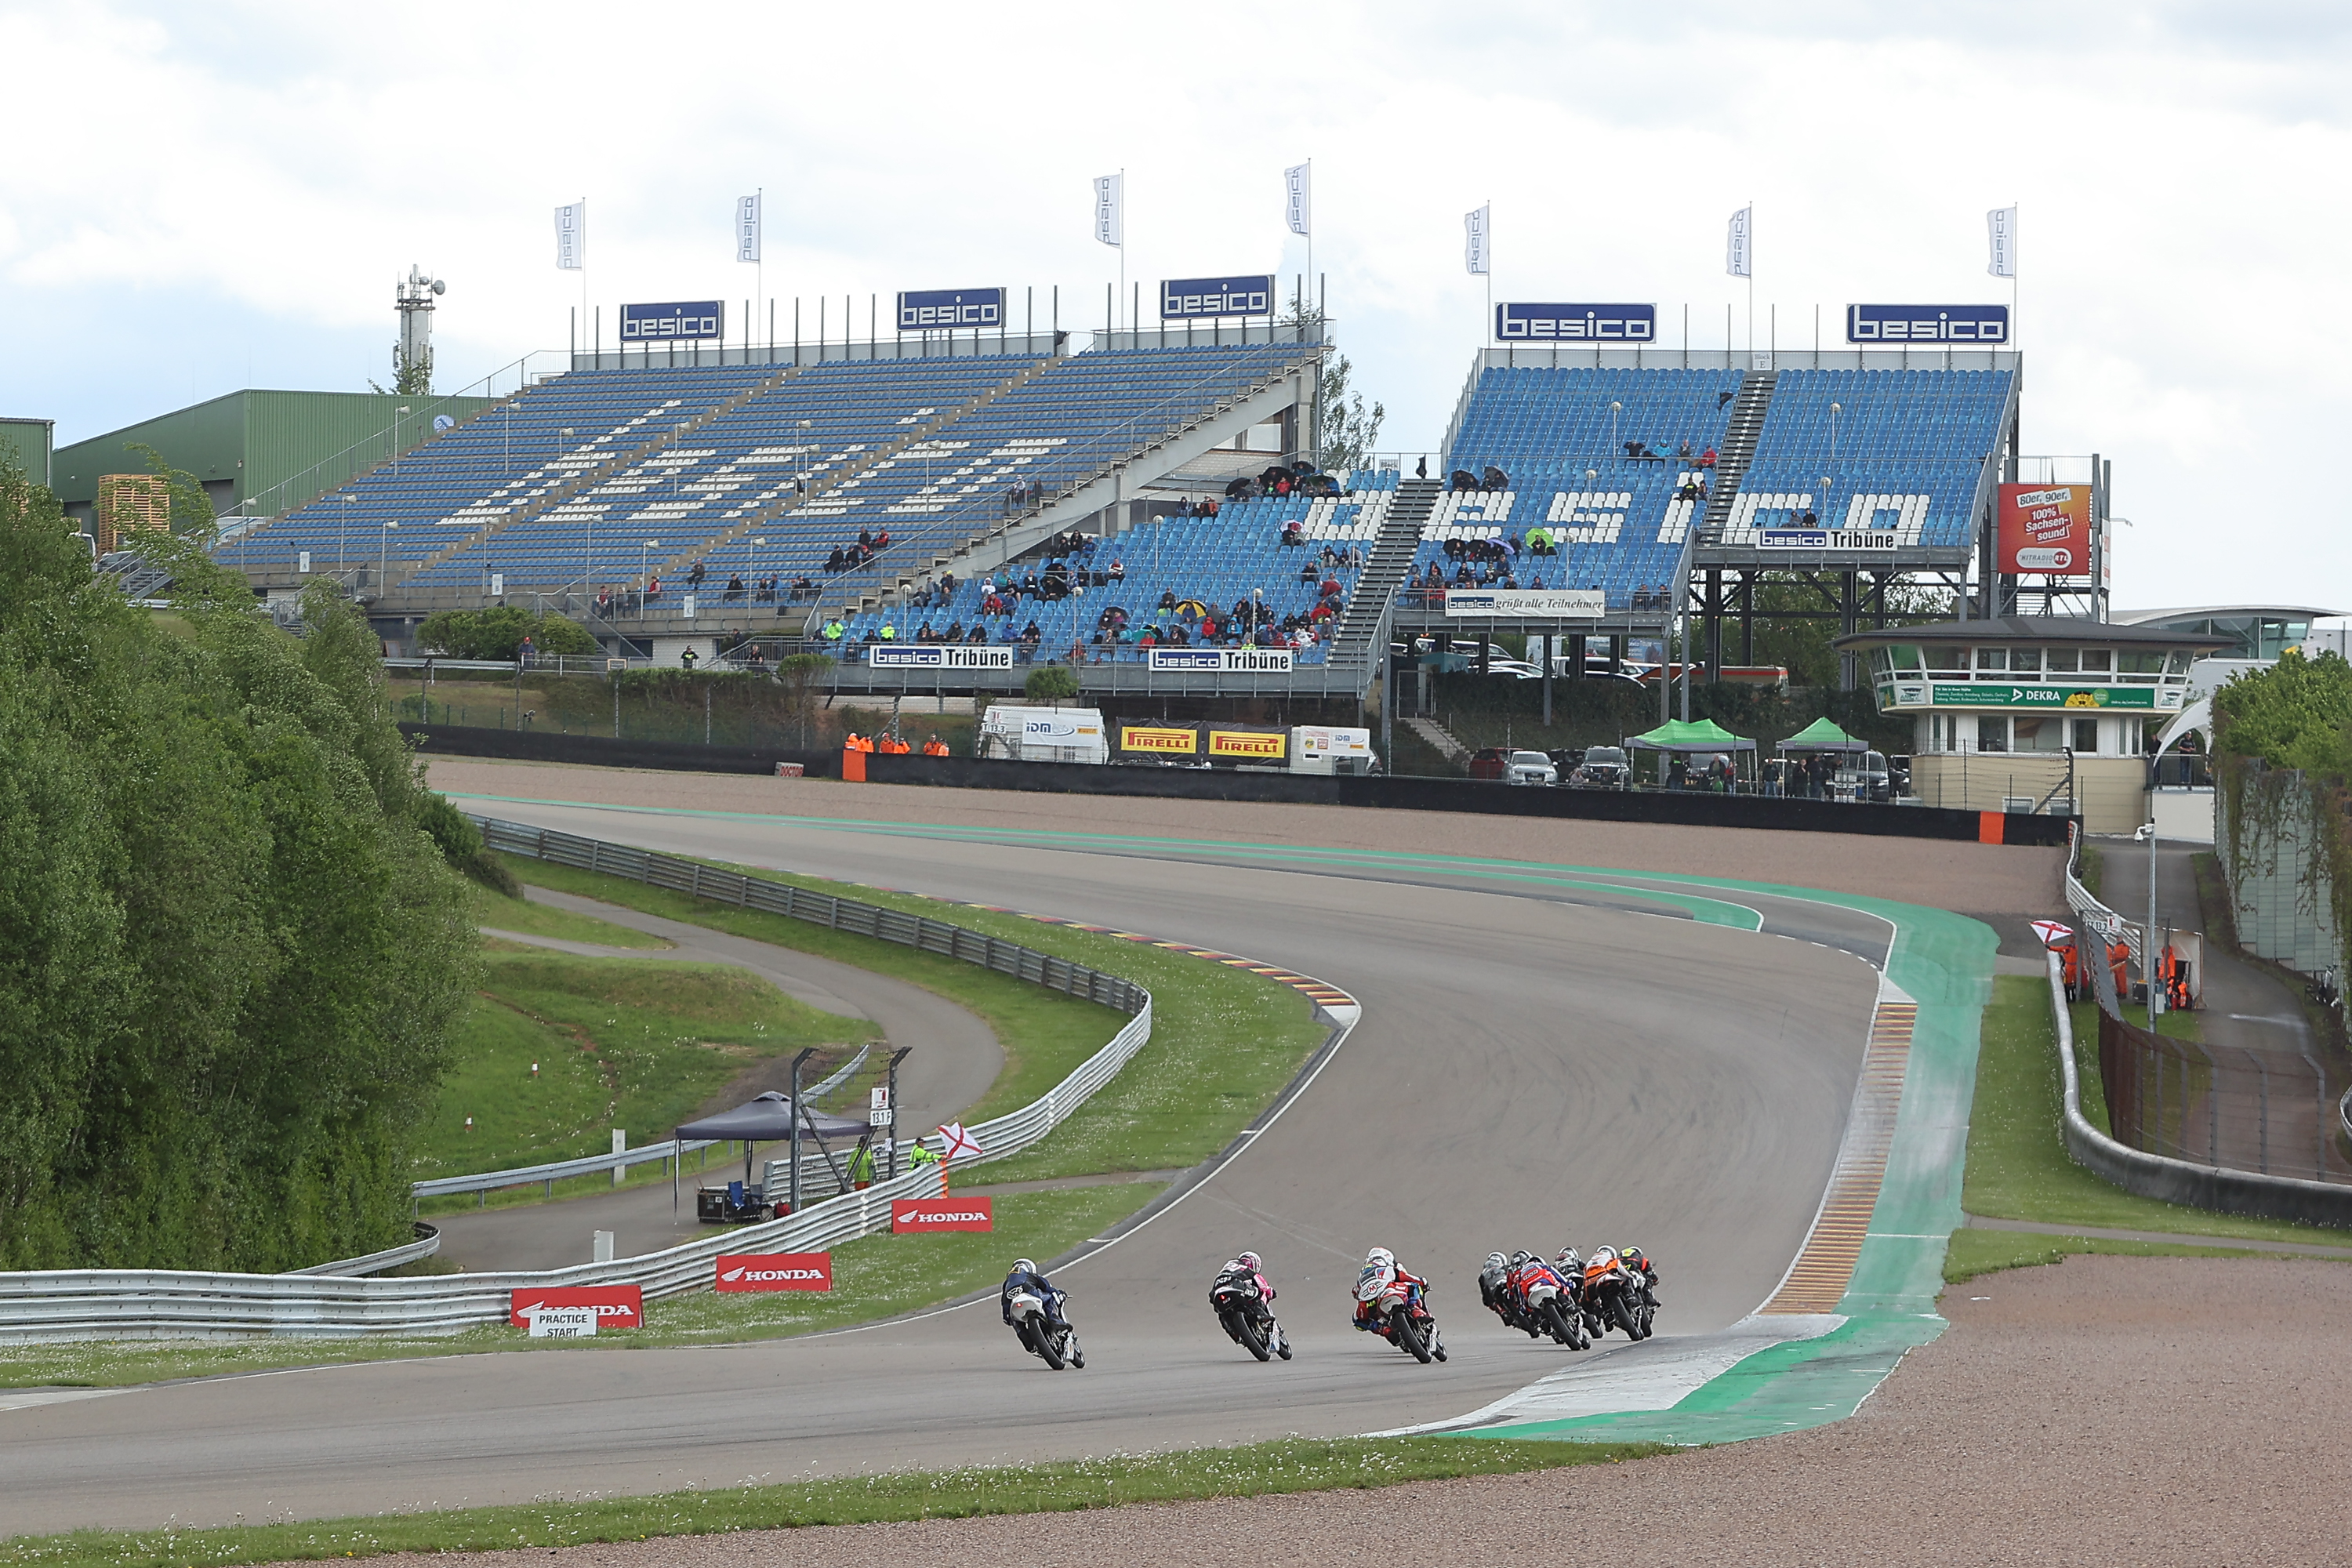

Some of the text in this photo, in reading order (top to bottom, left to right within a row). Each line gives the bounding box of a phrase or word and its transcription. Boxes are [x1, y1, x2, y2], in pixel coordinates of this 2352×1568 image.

[1164, 281, 1267, 314] besico
[900, 292, 997, 325] besico
[623, 305, 717, 336] besico
[1502, 303, 1650, 337] besico
[1853, 305, 2003, 339] besico
[2020, 491, 2068, 505] 80er, 90er,
[2031, 507, 2056, 520] 100%
[2025, 516, 2069, 532] Sachsen-
[1762, 531, 1894, 548] besico Tribüne
[2037, 527, 2065, 541] sound
[1448, 598, 1603, 609] besico grüßt alle Teilnehmer
[877, 648, 1009, 666] besico Tribüne
[1155, 652, 1288, 669] besico Tribüne
[2026, 691, 2061, 701] DEKRA
[1128, 732, 1190, 748] PIRELLI
[1216, 736, 1278, 752] PIRELLI
[780, 766, 804, 777] DOCTOR
[872, 1112, 891, 1124] 13.1 F
[918, 1212, 988, 1223] HONDA
[745, 1269, 825, 1281] HONDA
[539, 1315, 588, 1323] PRACTICE
[547, 1328, 579, 1337] START
